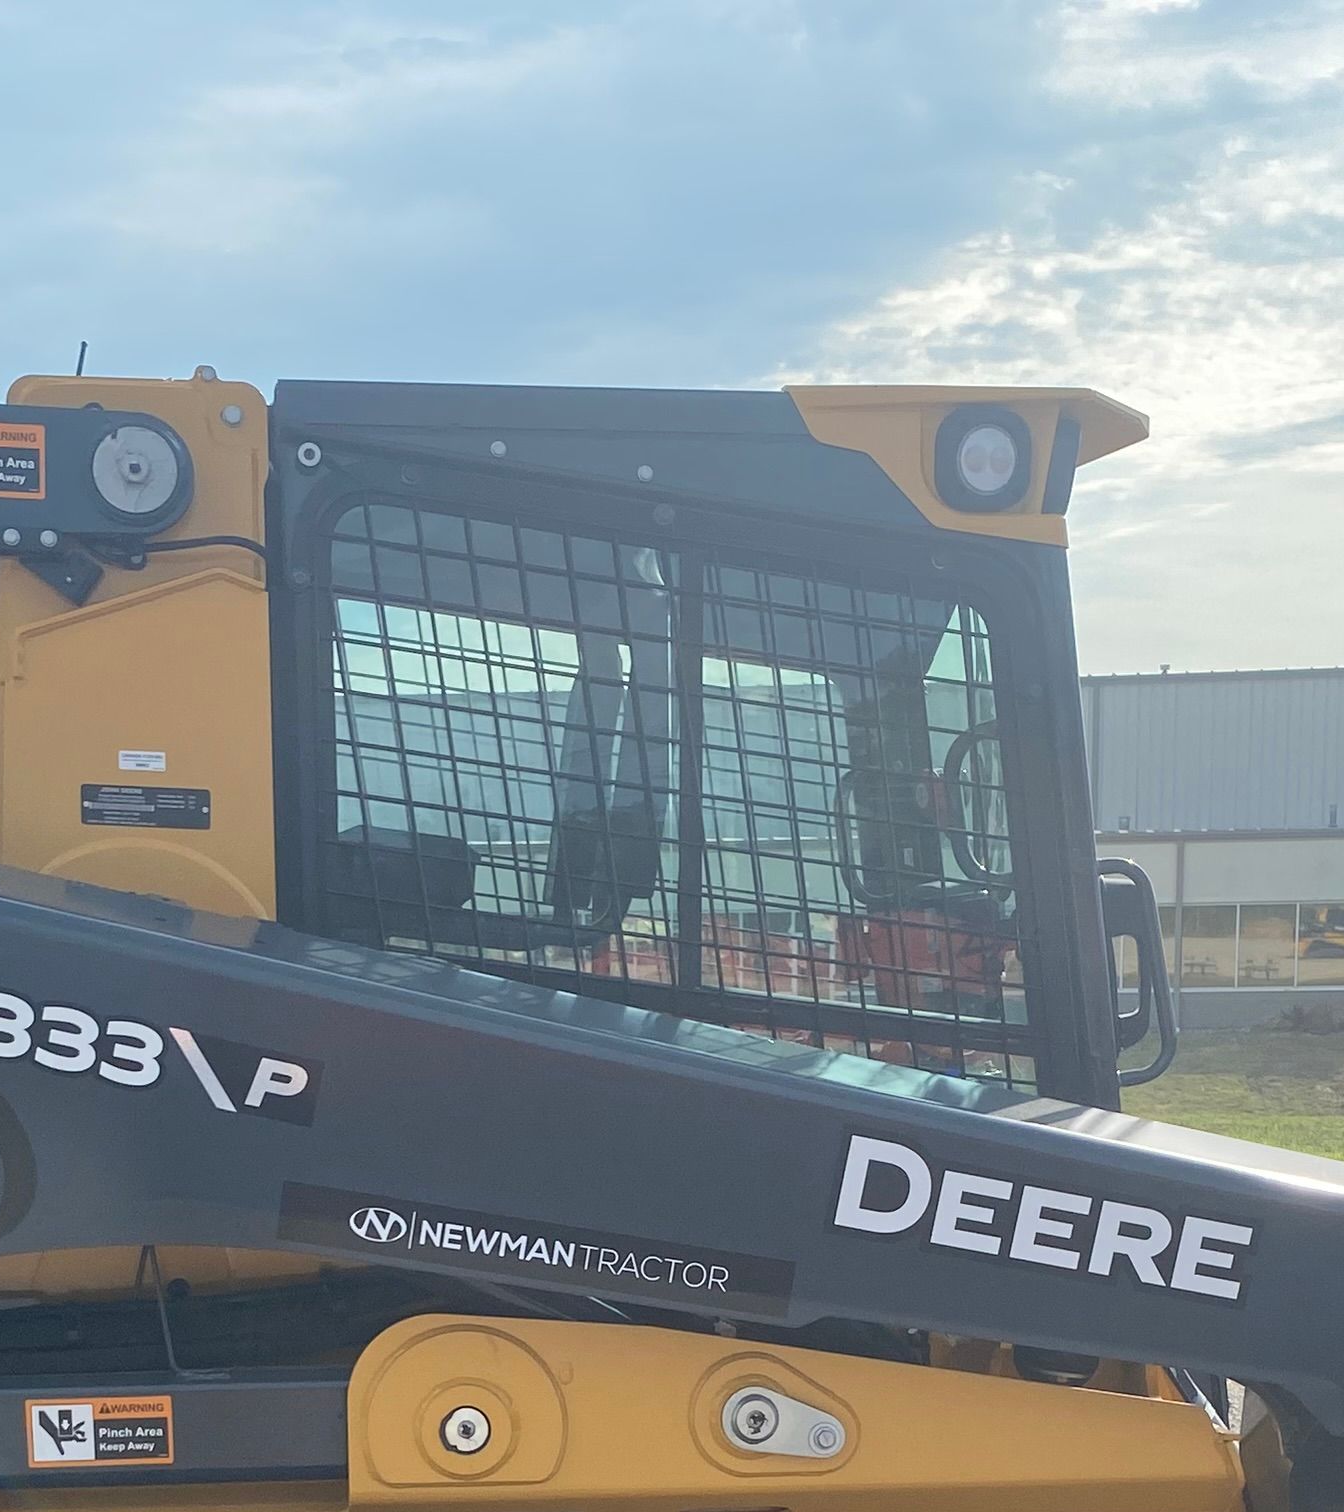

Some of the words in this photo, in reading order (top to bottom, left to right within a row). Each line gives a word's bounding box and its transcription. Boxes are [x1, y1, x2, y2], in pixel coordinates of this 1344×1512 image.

[6, 457, 35, 469] Area
[834, 1134, 1253, 1300] DEERE
[110, 1403, 165, 1413] WARNING
[98, 1427, 133, 1438] Pinch
[135, 1426, 164, 1437] Area
[99, 1443, 126, 1452] Keep
[127, 1441, 155, 1452] Away
